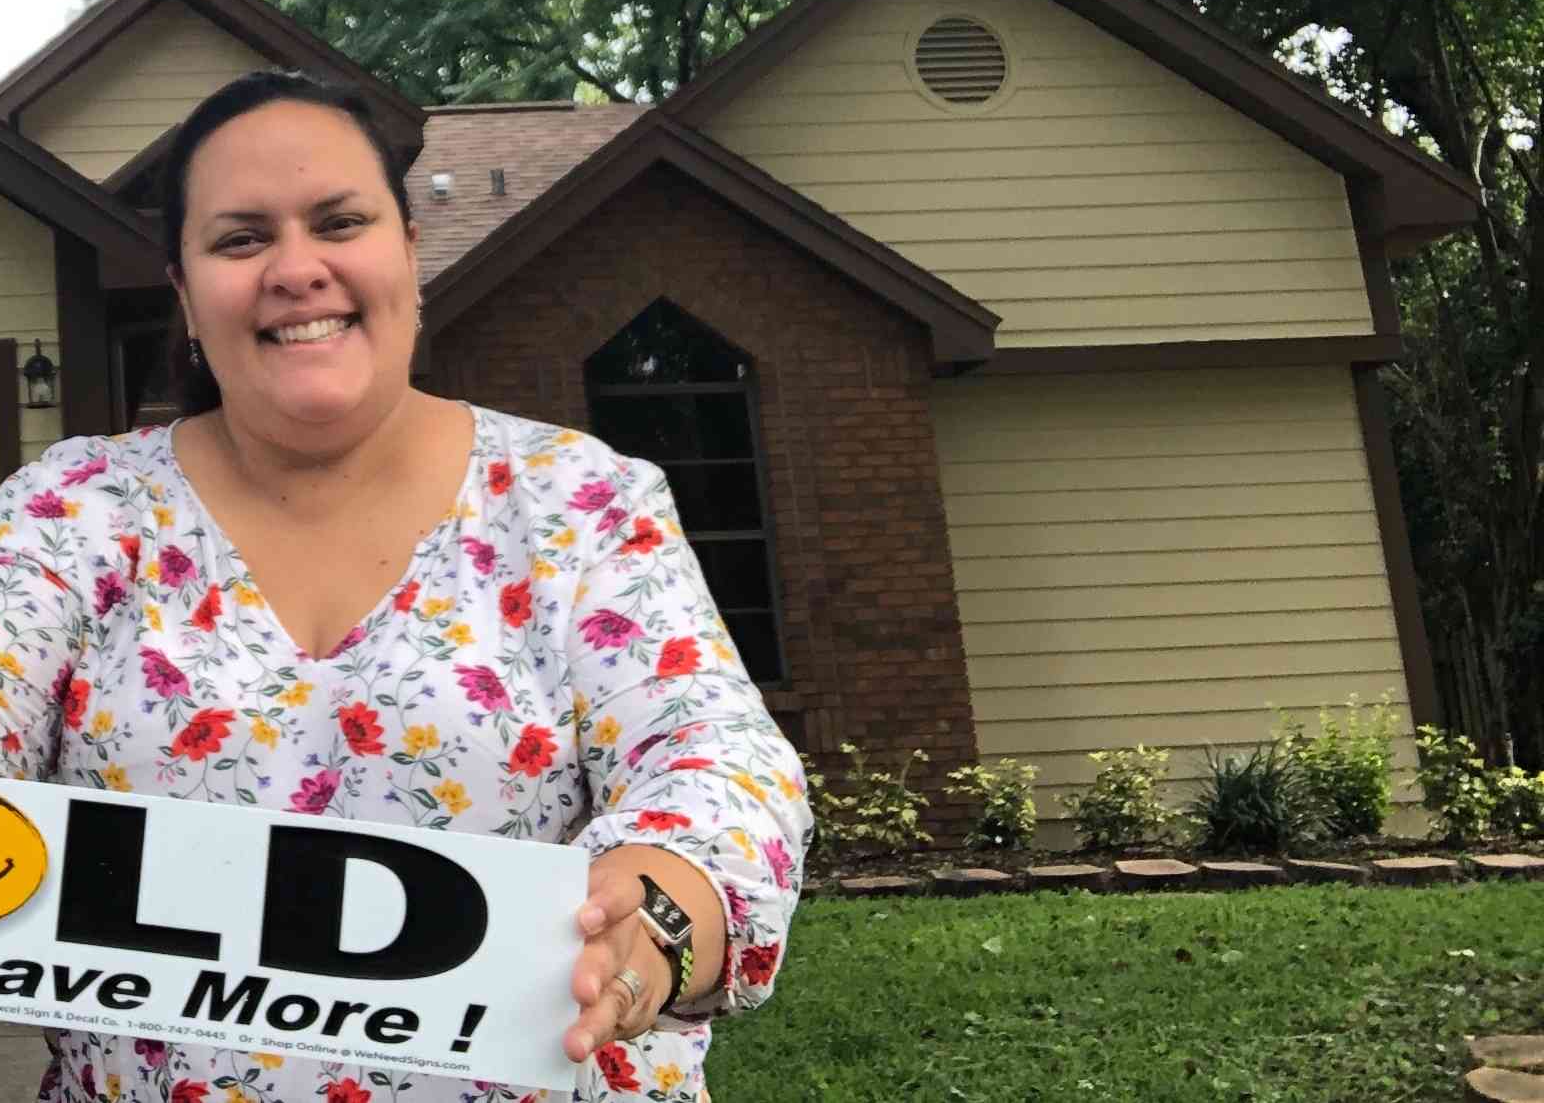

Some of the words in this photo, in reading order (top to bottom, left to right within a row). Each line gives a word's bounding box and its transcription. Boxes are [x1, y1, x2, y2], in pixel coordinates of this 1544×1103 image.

[24, 1007, 49, 1019] Sign
[53, 1010, 62, 1019] &
[66, 1012, 99, 1025] Decal
[239, 1034, 253, 1044] Or
[261, 1037, 293, 1050] Shop
[296, 1041, 337, 1055] Online
[355, 1049, 471, 1072] WeNeedSigns.com
[181, 969, 421, 1045] More
[449, 1003, 488, 1053] !
